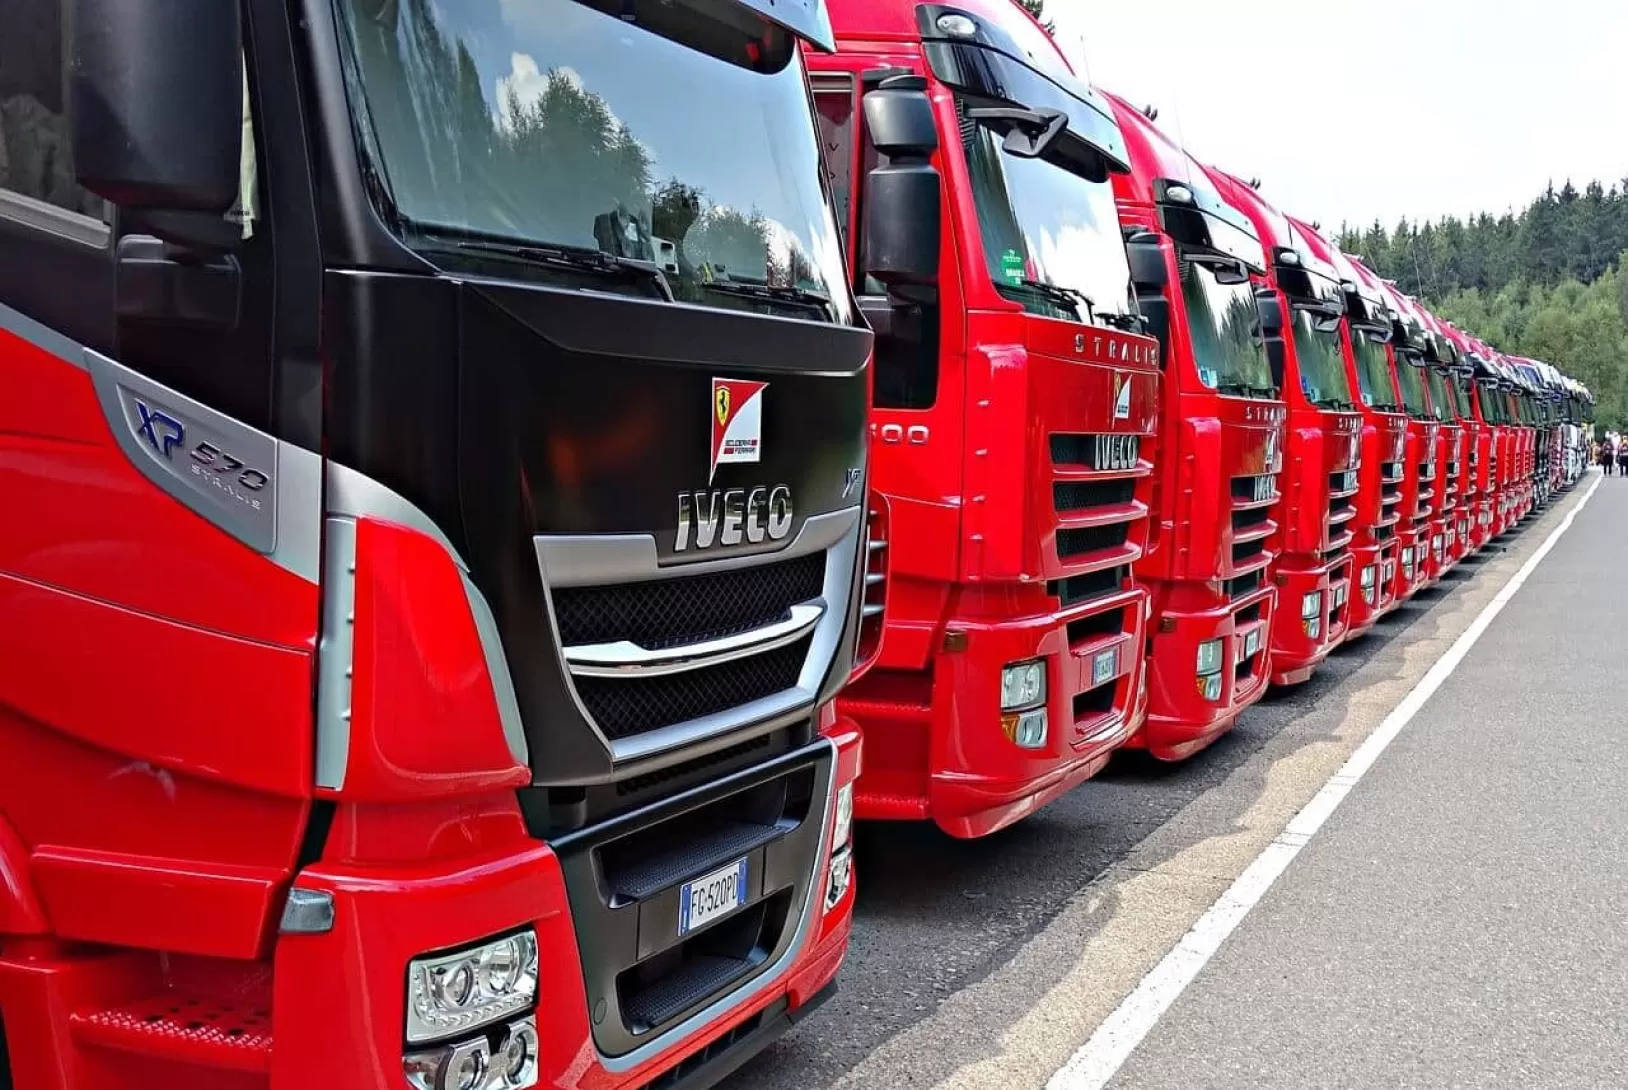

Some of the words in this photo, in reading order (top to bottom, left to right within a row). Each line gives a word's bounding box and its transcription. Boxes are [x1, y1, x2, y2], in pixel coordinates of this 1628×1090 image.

[1075, 333, 1158, 365] STRALIS
[134, 397, 185, 461] XP
[190, 440, 270, 491] 570
[1094, 434, 1139, 471] IVECO
[674, 484, 794, 552] IVECO
